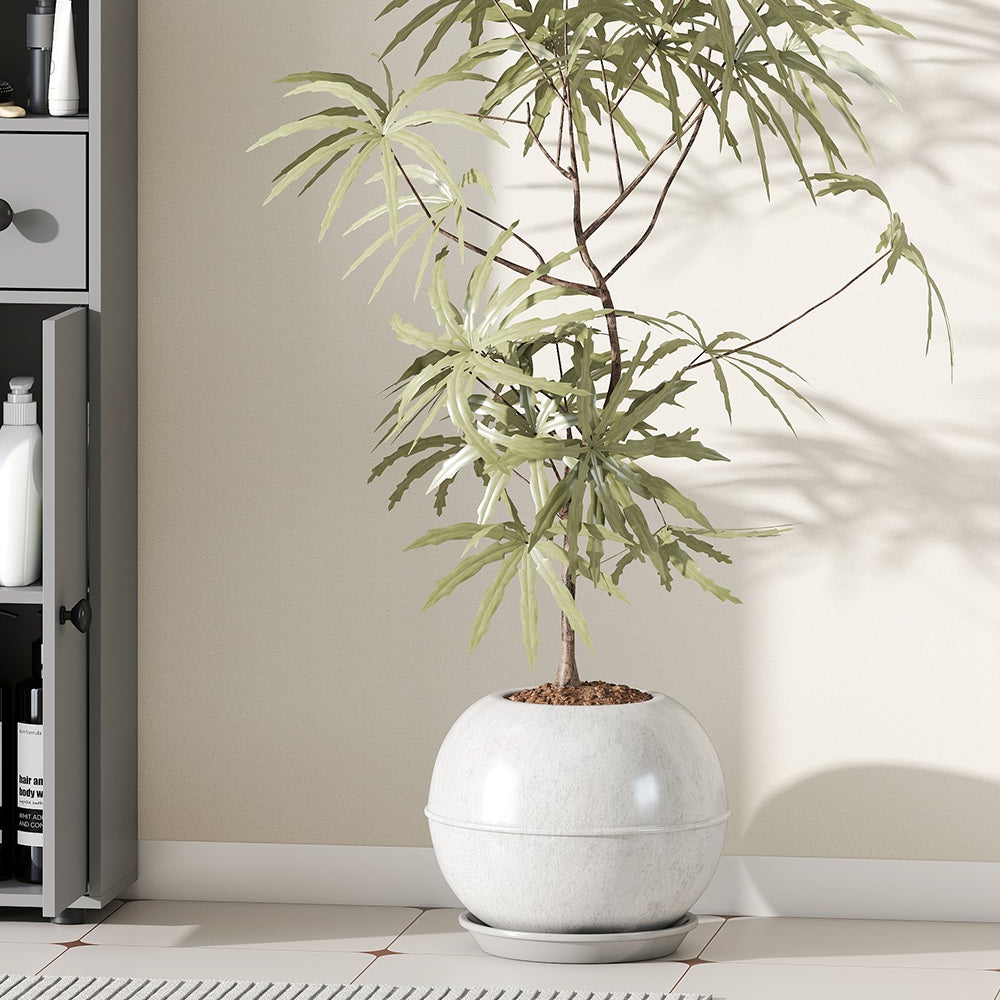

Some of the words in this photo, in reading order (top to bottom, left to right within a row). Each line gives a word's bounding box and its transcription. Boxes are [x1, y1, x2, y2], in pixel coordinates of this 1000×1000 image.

[19, 774, 32, 785] hair
[33, 777, 43, 785] an
[19, 786, 35, 798] body
